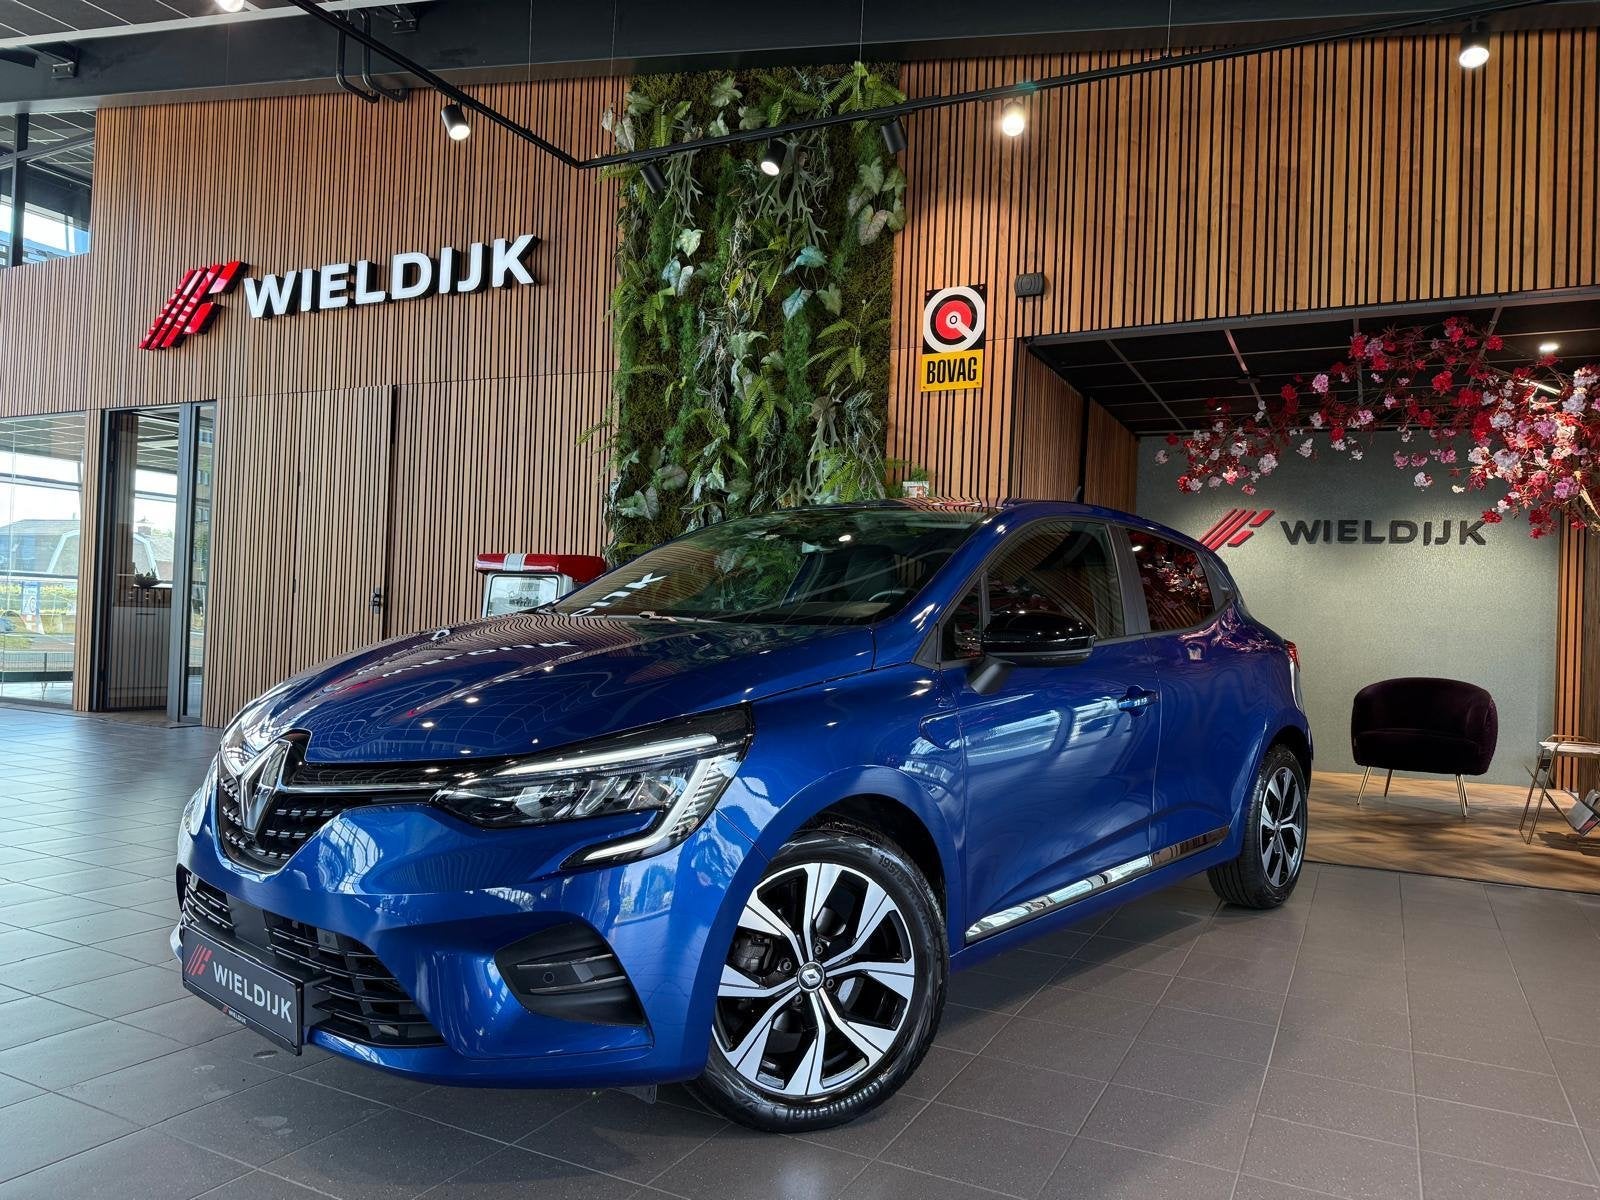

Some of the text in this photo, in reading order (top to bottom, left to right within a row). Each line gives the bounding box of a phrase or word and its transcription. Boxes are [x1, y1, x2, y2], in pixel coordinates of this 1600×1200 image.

[244, 234, 537, 319] WIELDIJK
[926, 357, 978, 384] BOVAG
[1280, 519, 1486, 546] WIELDIJK
[213, 961, 292, 1023] WIELDIJK
